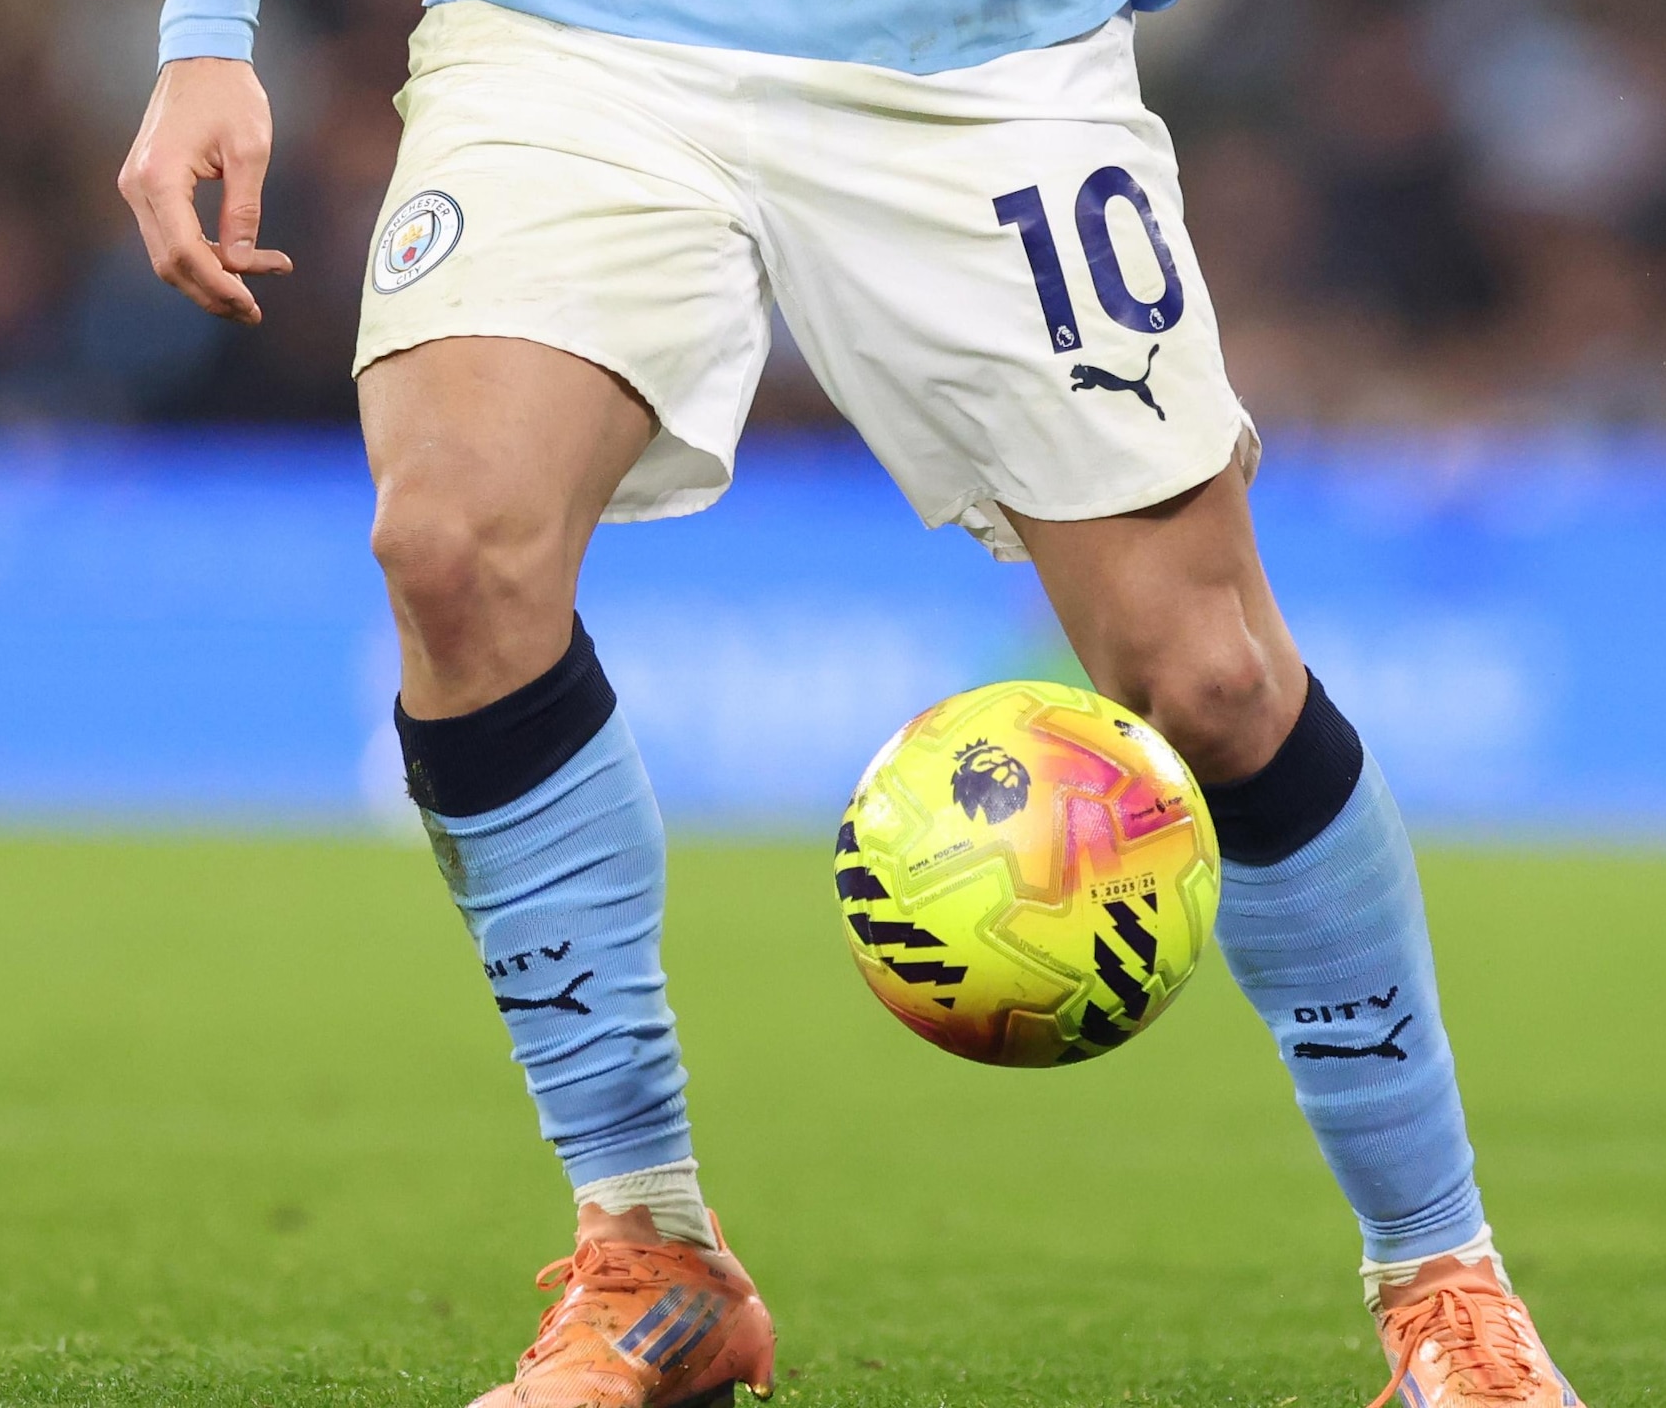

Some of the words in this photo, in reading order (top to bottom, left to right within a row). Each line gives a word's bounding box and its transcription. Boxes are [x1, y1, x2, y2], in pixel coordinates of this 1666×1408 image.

[382, 198, 450, 249] MANCHESTER
[396, 267, 422, 285] CITY
[992, 165, 1184, 354] 10
[909, 858, 930, 873] PUMA
